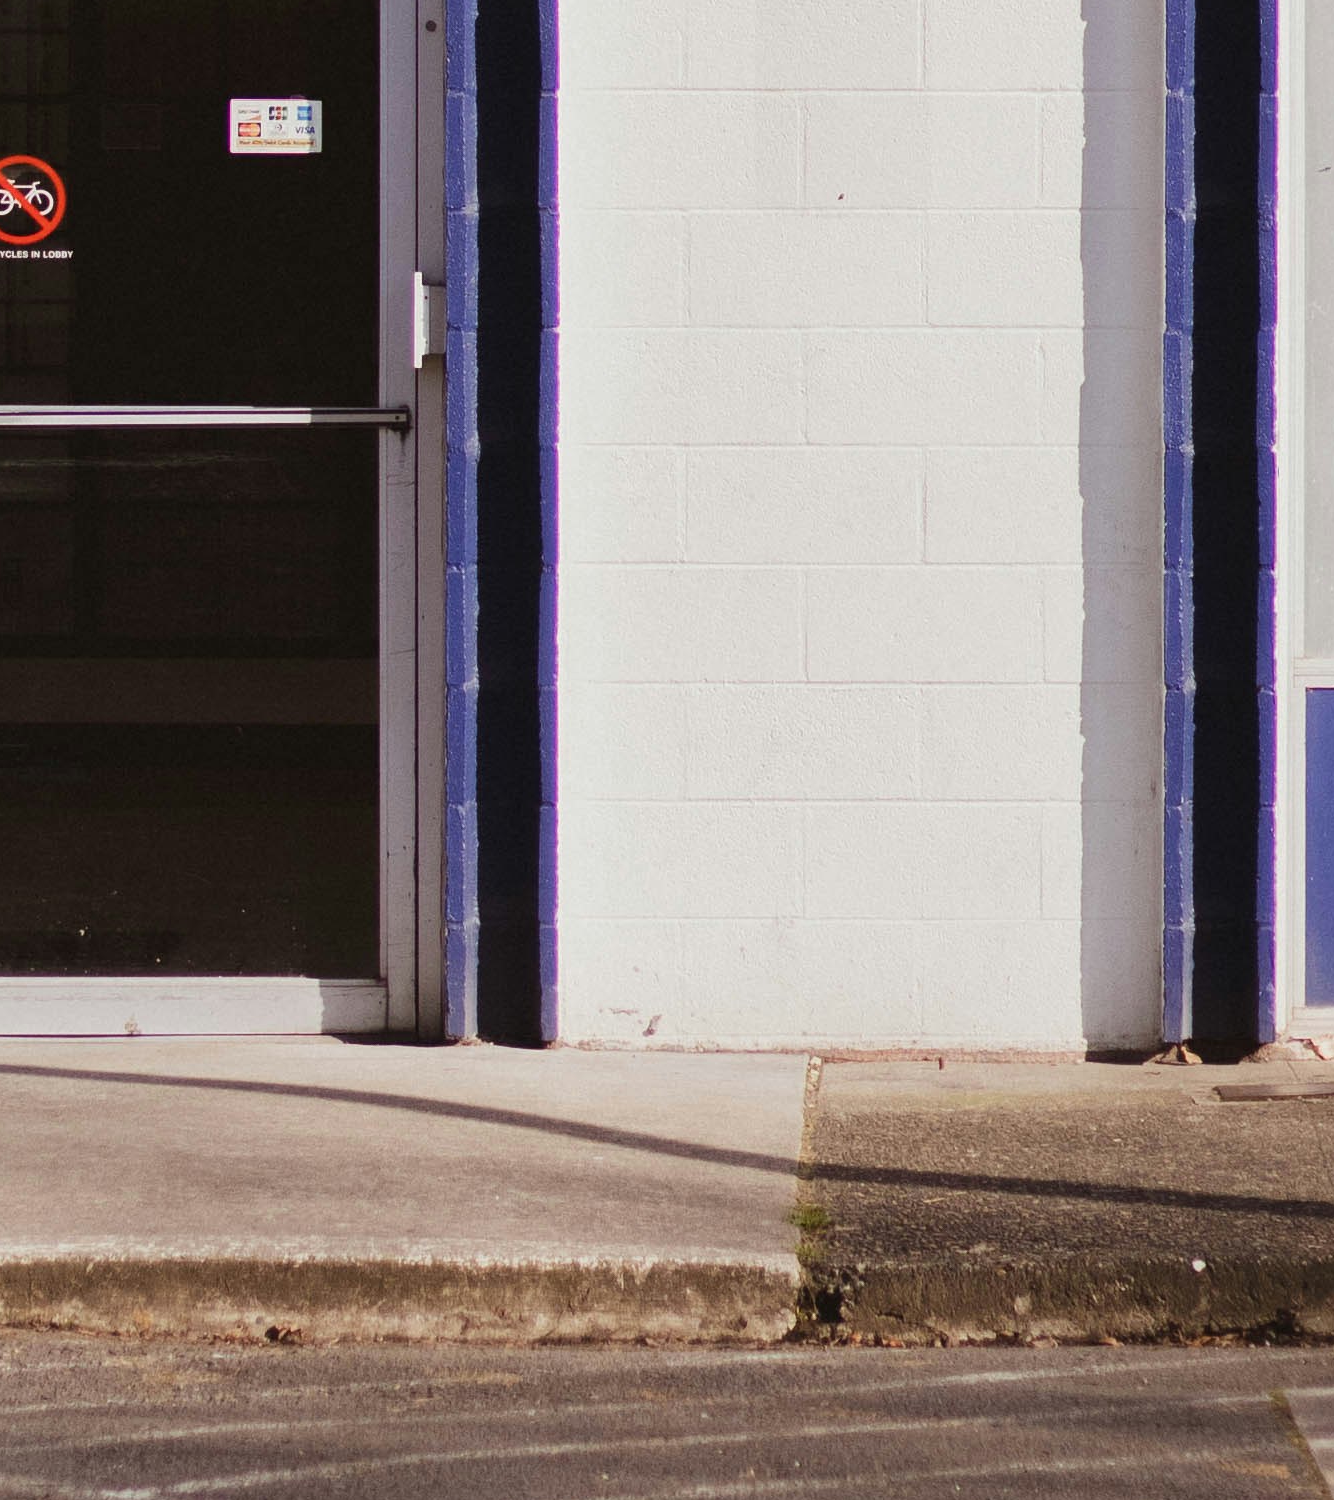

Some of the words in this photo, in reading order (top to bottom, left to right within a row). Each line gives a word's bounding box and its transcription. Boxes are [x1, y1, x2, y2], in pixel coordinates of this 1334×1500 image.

[295, 126, 315, 134] VISA
[30, 250, 41, 259] IN
[42, 250, 74, 259] LOBBY
